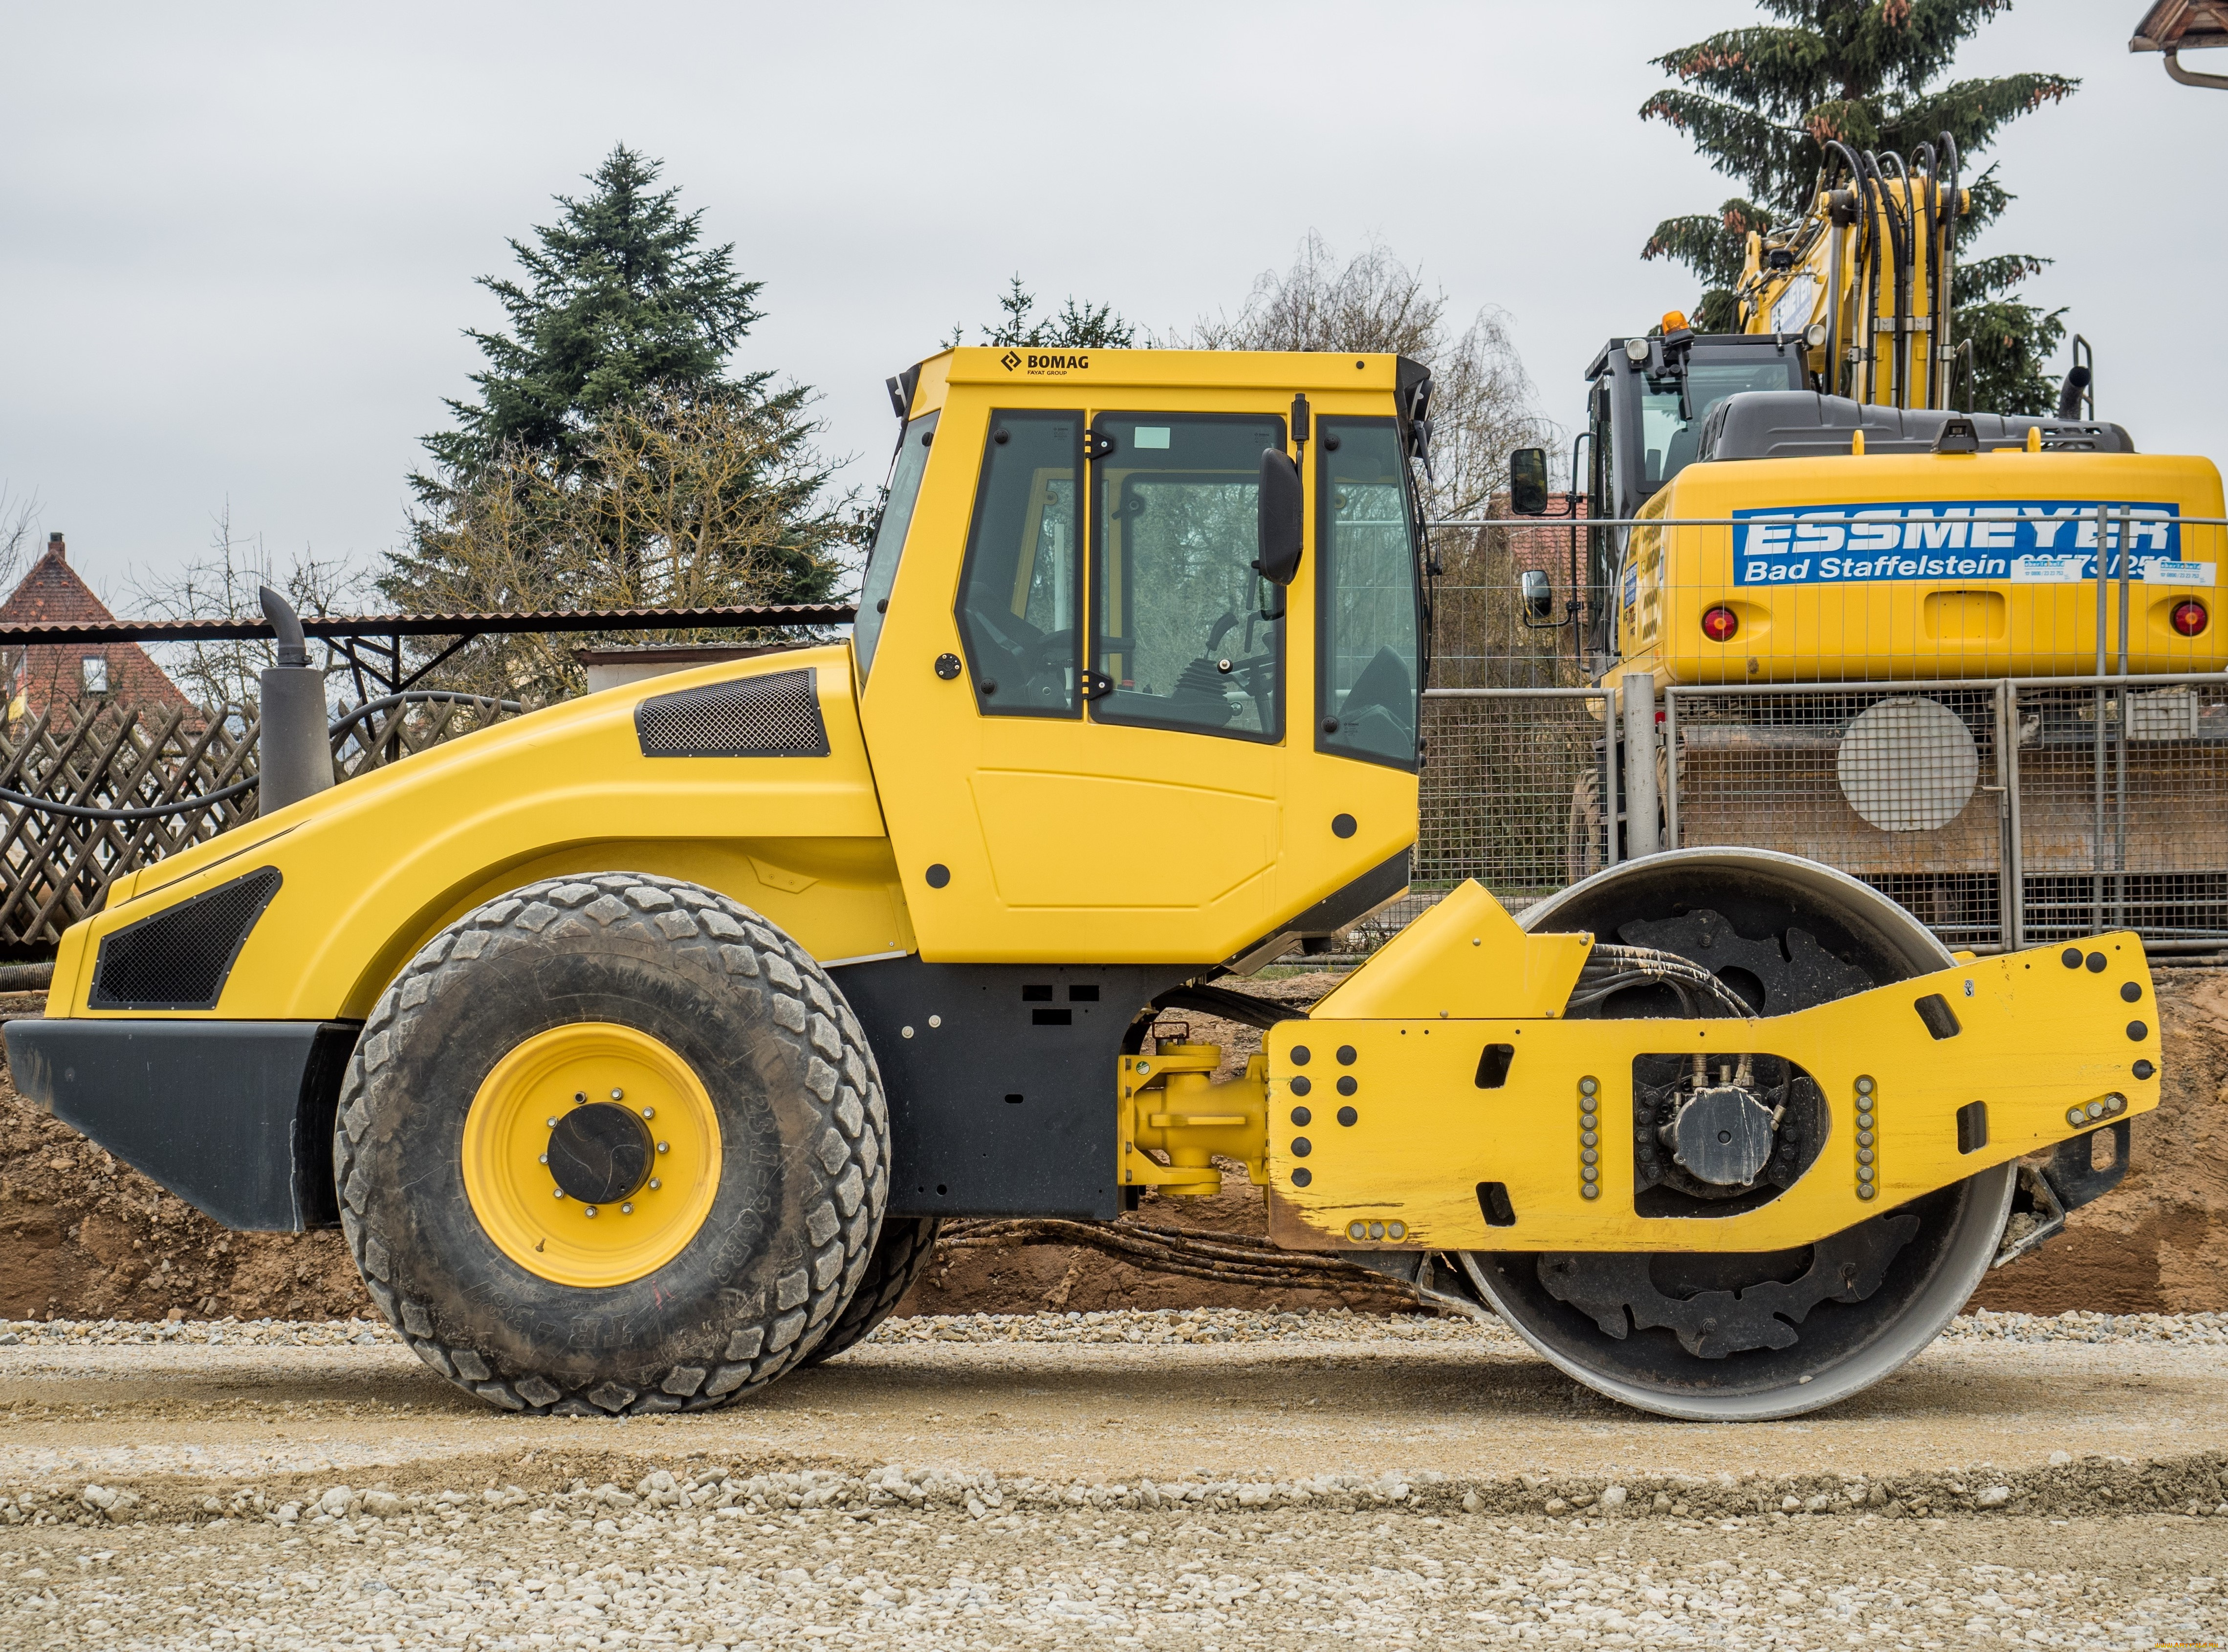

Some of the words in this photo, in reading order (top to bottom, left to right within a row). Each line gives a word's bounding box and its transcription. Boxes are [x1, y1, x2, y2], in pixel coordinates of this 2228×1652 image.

[1027, 355, 1089, 369] BOMAG
[1744, 508, 2171, 556] ESSMEYER
[1744, 559, 1811, 582] Bad
[1819, 554, 2006, 578] Staffelstein
